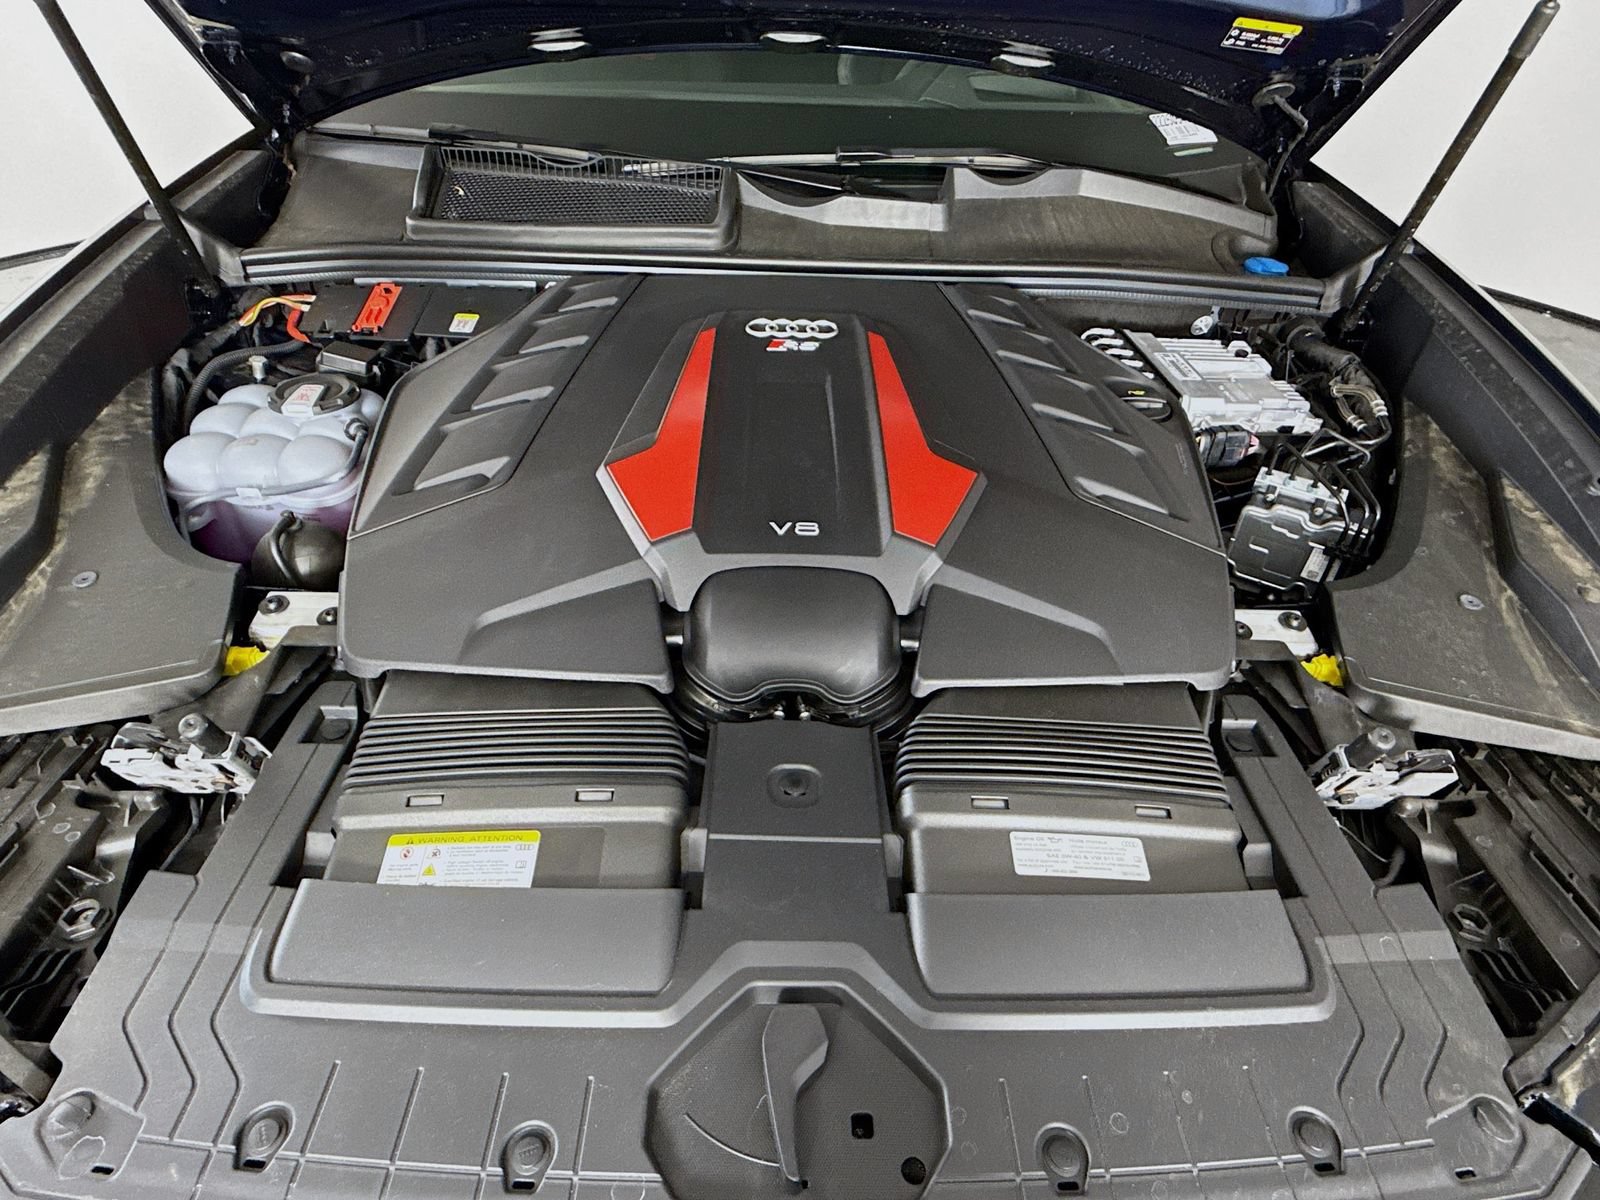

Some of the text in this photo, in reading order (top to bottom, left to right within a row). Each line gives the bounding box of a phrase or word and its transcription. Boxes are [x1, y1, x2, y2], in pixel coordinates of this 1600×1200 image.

[768, 521, 820, 536] V8
[418, 834, 523, 844] WARNING ATTENTION
